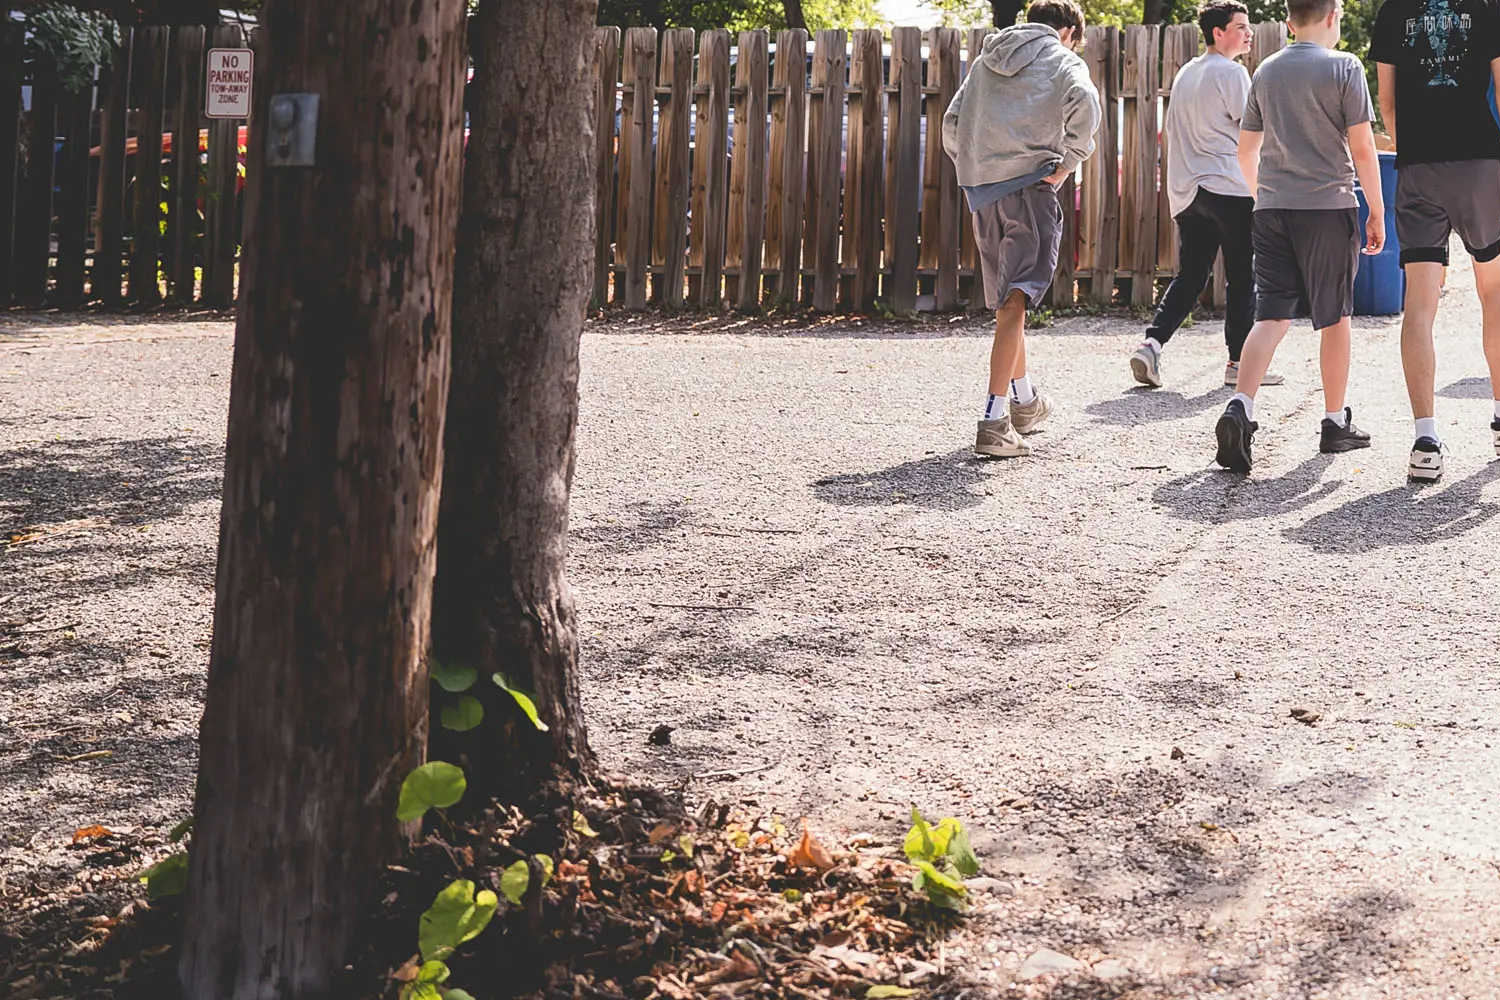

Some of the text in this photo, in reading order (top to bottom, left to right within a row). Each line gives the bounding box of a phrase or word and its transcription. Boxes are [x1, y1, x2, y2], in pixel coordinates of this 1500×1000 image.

[222, 55, 238, 68] NO
[1420, 55, 1460, 65] ZAMAMI
[210, 70, 249, 83] PARKING
[211, 84, 249, 93] TOW-AWAY
[218, 94, 239, 104] ZONE
